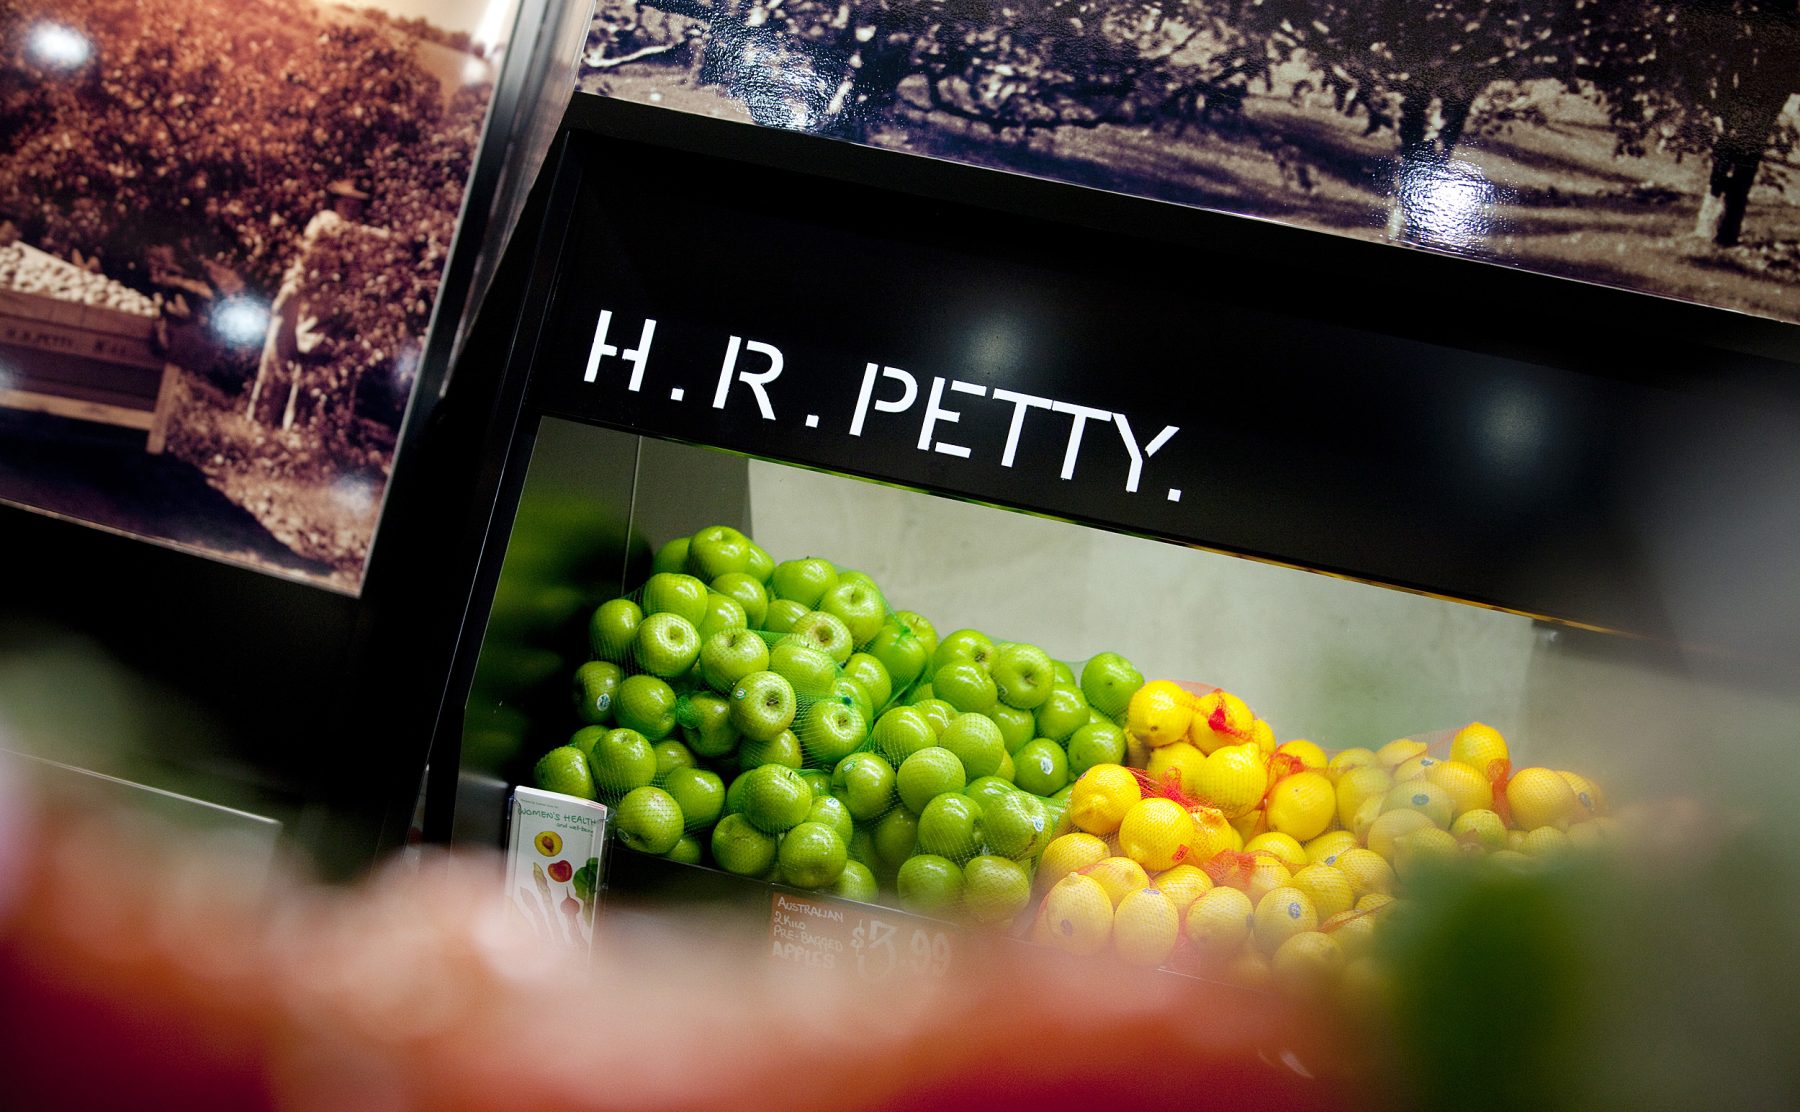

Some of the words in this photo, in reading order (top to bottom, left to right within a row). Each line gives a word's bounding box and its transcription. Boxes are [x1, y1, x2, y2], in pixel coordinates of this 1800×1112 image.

[849, 363, 1181, 501] PETTY.
[518, 808, 560, 821] WOMEN'S
[564, 815, 597, 826] HEALTH
[777, 896, 844, 923] AUSTRALIAN
[772, 924, 844, 952] PRE-BAGGED
[772, 940, 836, 969] APPLES
